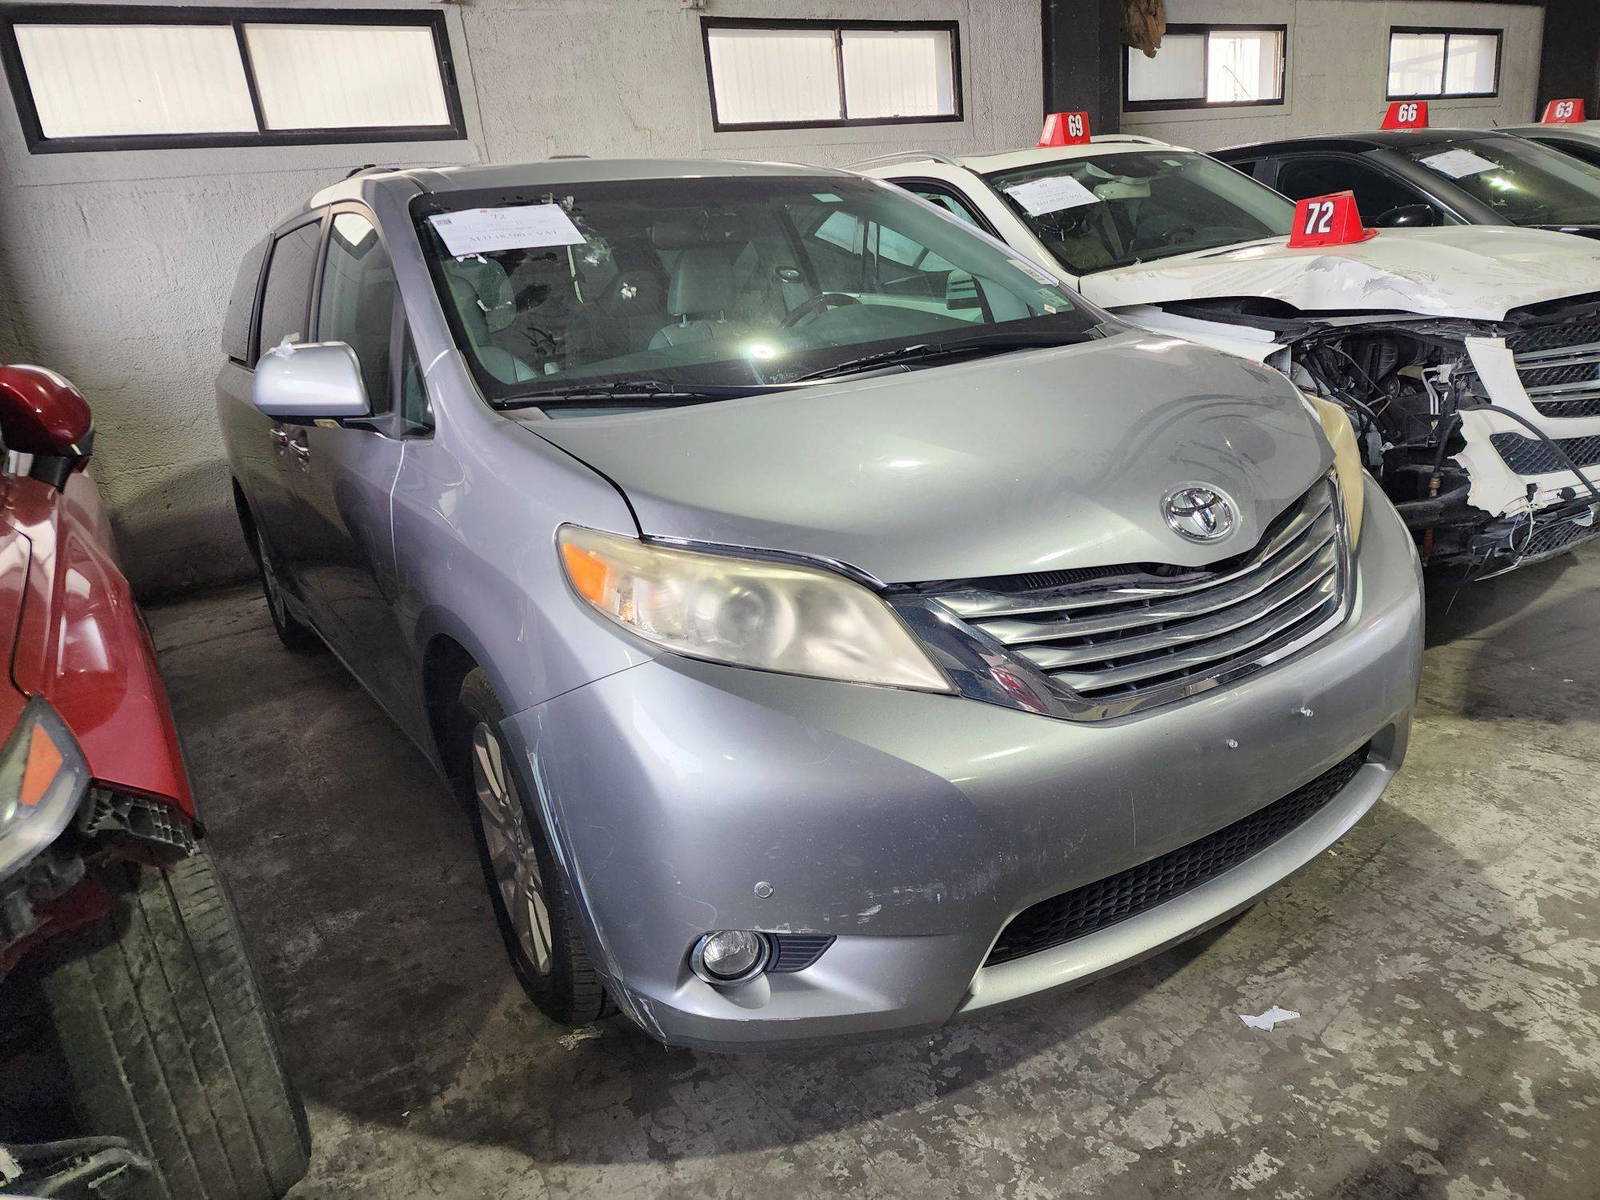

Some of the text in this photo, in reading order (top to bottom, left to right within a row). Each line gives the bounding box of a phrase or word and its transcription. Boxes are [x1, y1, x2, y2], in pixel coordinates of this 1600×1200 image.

[1398, 103, 1418, 122] 66
[1556, 101, 1574, 118] 63
[1068, 114, 1084, 137] 69
[1305, 201, 1334, 235] 72
